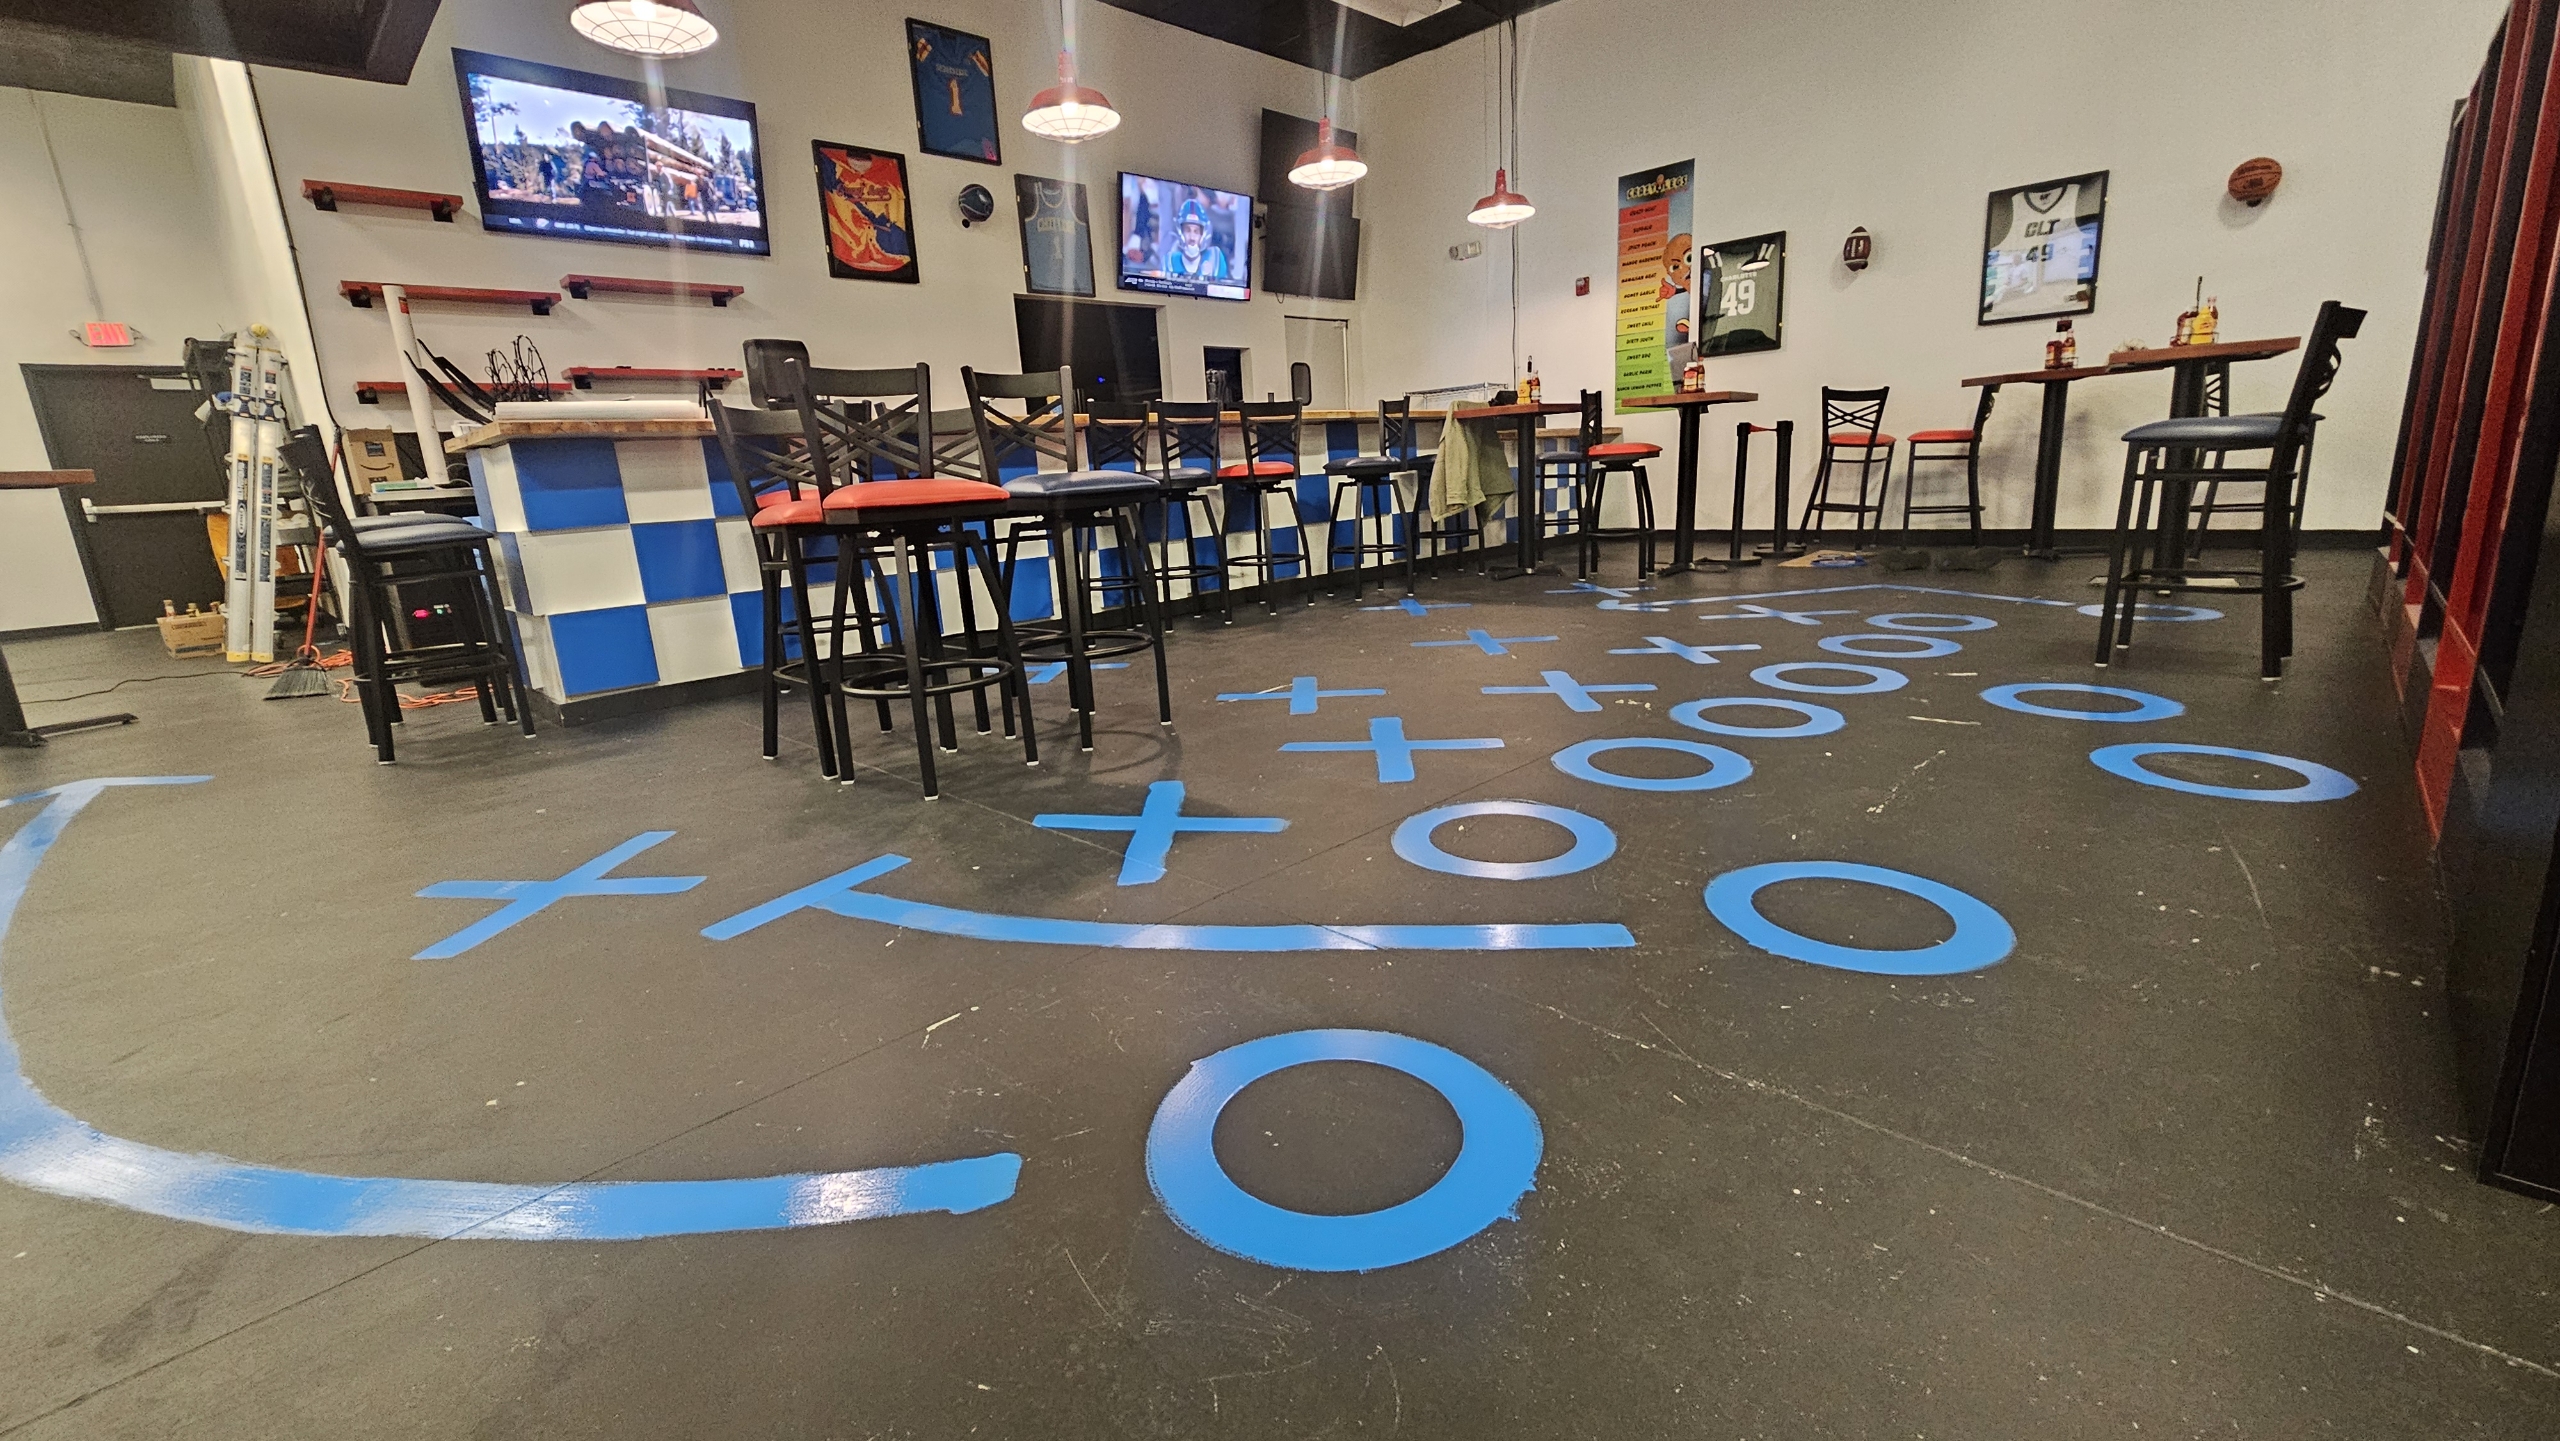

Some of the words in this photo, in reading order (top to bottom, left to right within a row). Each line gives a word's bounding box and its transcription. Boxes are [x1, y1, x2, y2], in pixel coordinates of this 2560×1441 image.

[2024, 219, 2061, 237] CLT
[2026, 244, 2054, 263] 49
[1720, 279, 1756, 317] 49
[86, 322, 130, 346] EXIT
